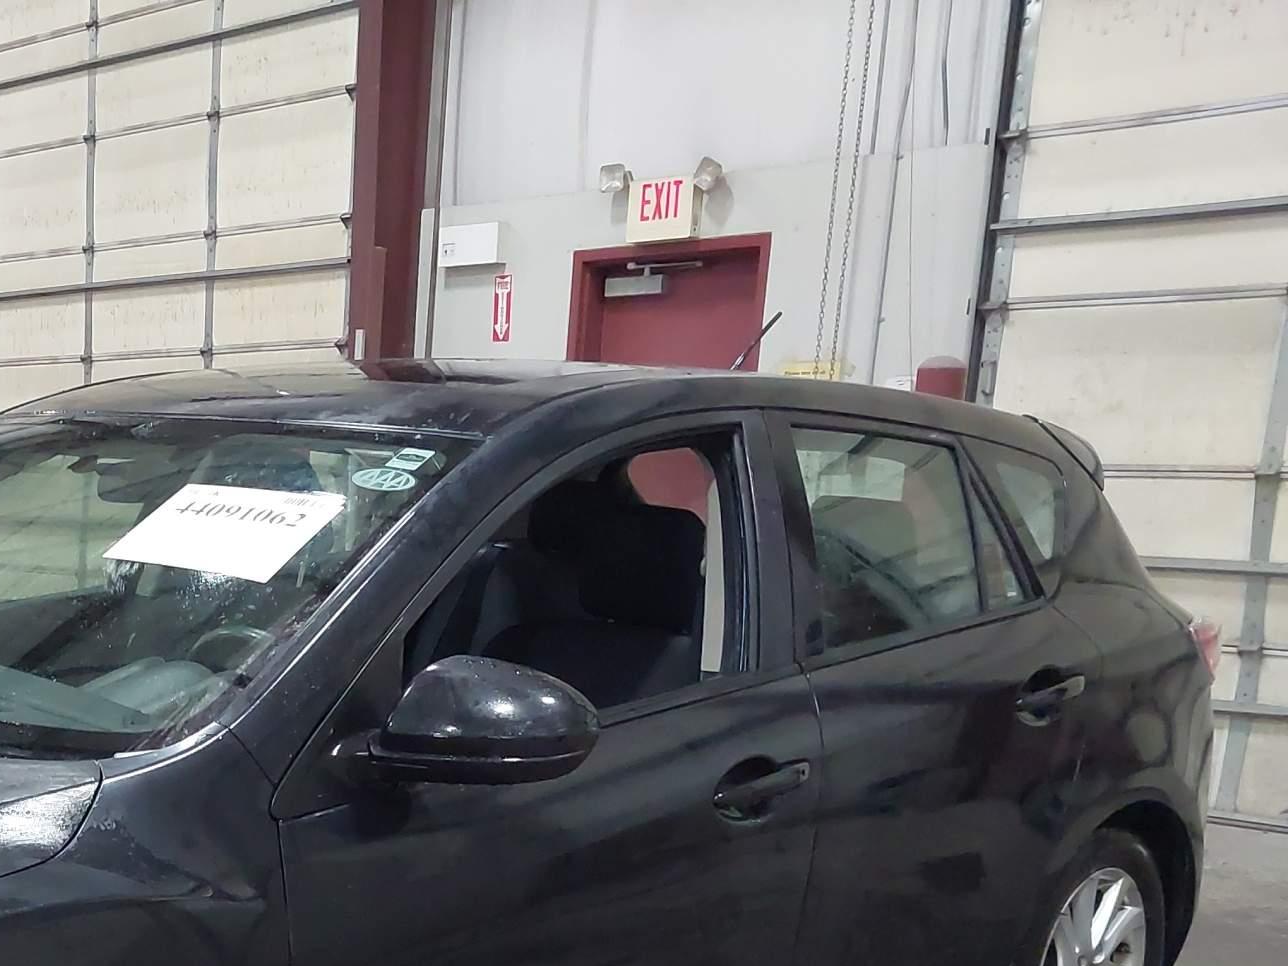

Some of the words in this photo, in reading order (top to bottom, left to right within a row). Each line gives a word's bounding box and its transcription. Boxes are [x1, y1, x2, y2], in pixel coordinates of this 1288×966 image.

[639, 180, 683, 221] EXIT
[357, 469, 411, 489] AAA
[175, 501, 307, 527] 44091062
